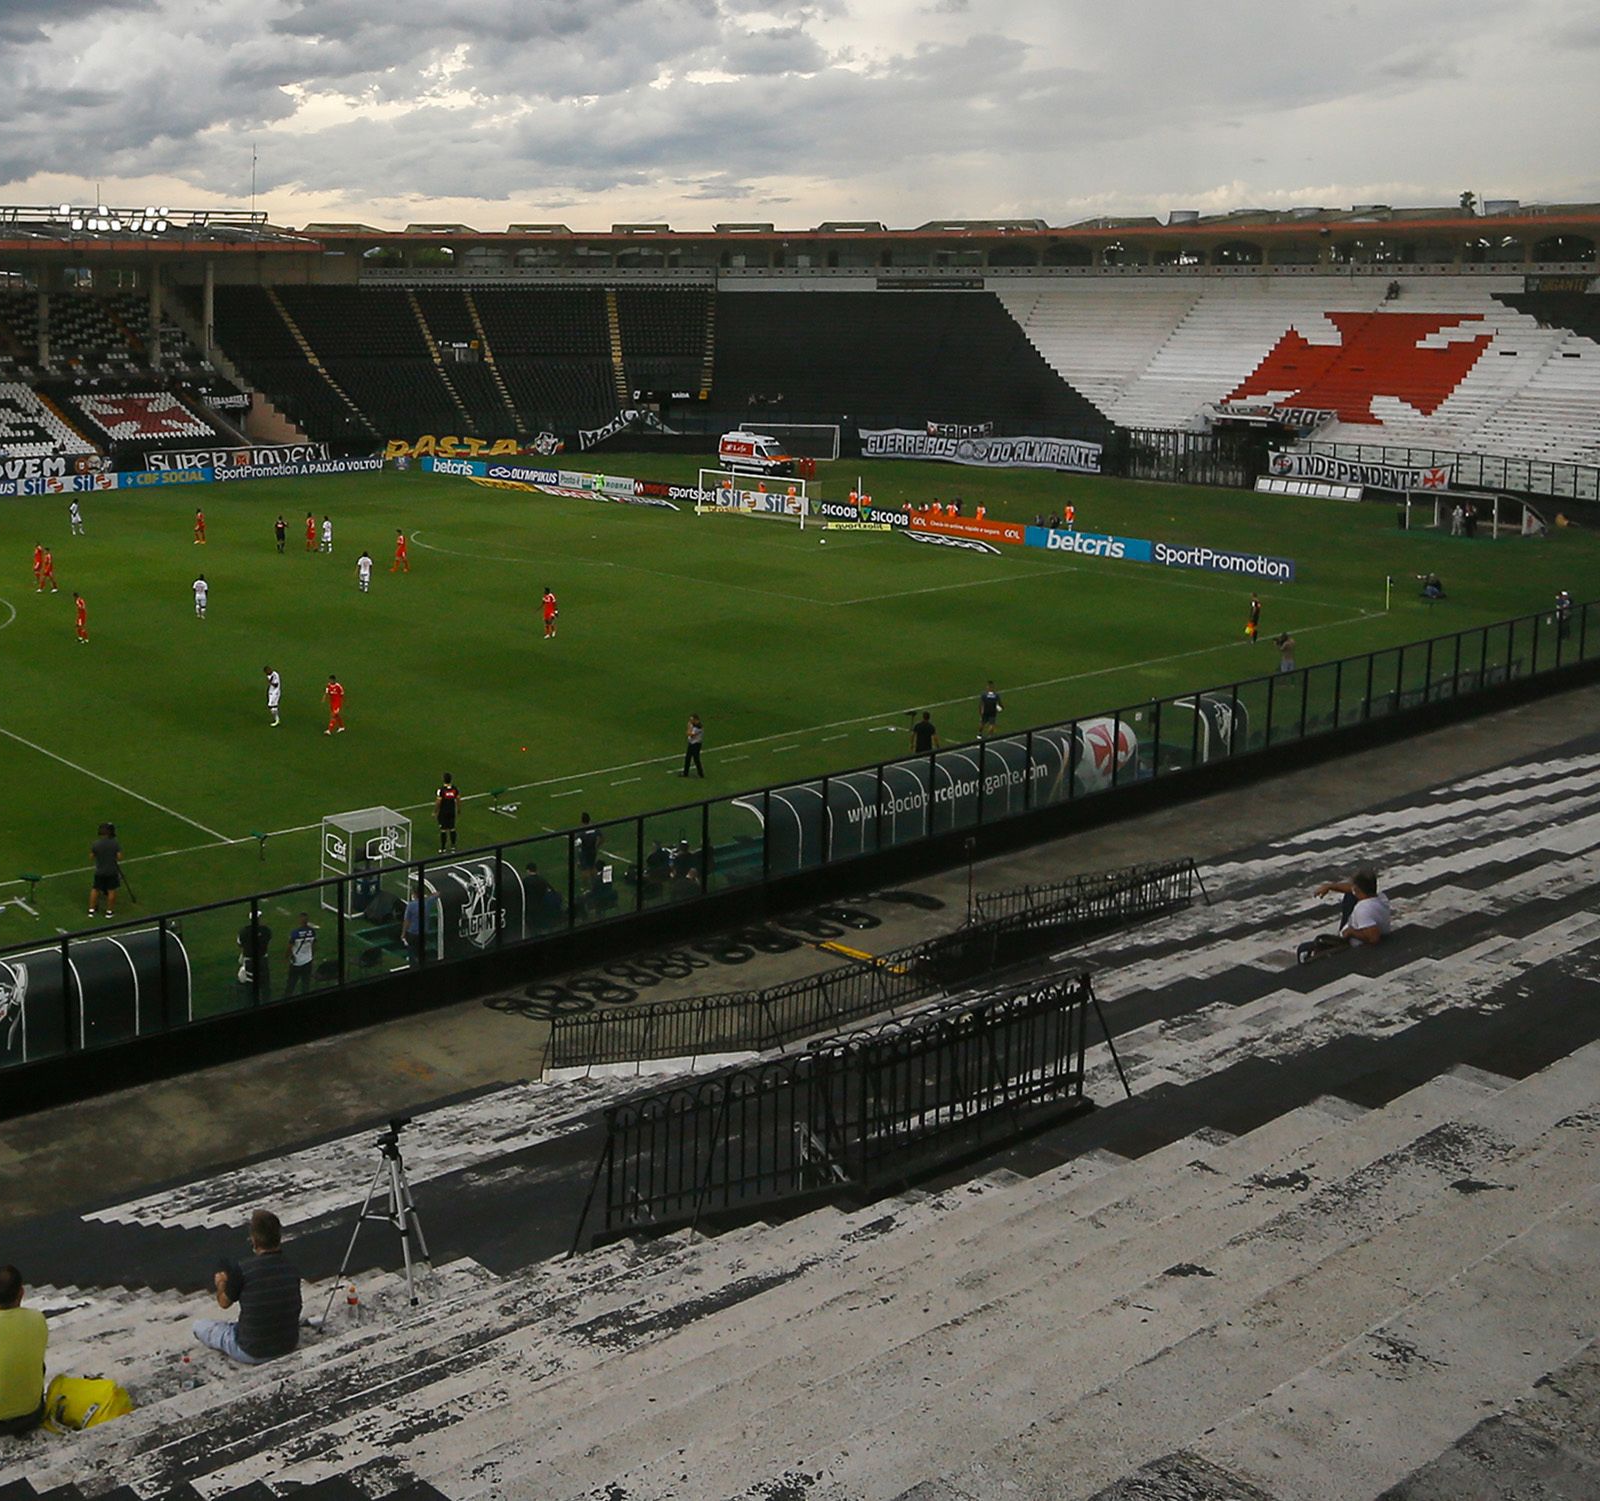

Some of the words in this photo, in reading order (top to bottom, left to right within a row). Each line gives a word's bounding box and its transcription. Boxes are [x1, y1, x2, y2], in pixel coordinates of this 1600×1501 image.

[866, 434, 957, 457] GUERREIROS
[989, 442, 1010, 462] DO
[1011, 441, 1099, 468] ALMIRANTE
[214, 462, 299, 481] SportPromotion
[301, 462, 309, 475] A
[309, 458, 346, 473] PAIXÃO
[346, 457, 385, 472] VOLTOU
[433, 457, 474, 476] betcris
[511, 467, 558, 485] OLYMPIKUS
[1297, 455, 1421, 489] INDEPENDENTE
[73, 475, 94, 491] Sil
[137, 472, 160, 486] CBF
[161, 469, 205, 484] SOCIAL
[24, 480, 45, 496] Sil
[721, 489, 741, 508] Sil
[765, 494, 785, 513] Sil
[821, 502, 858, 520] SICOOB
[870, 509, 909, 527] SICOOB
[1046, 529, 1126, 559] betcris
[1154, 543, 1290, 579] SportPromotion
